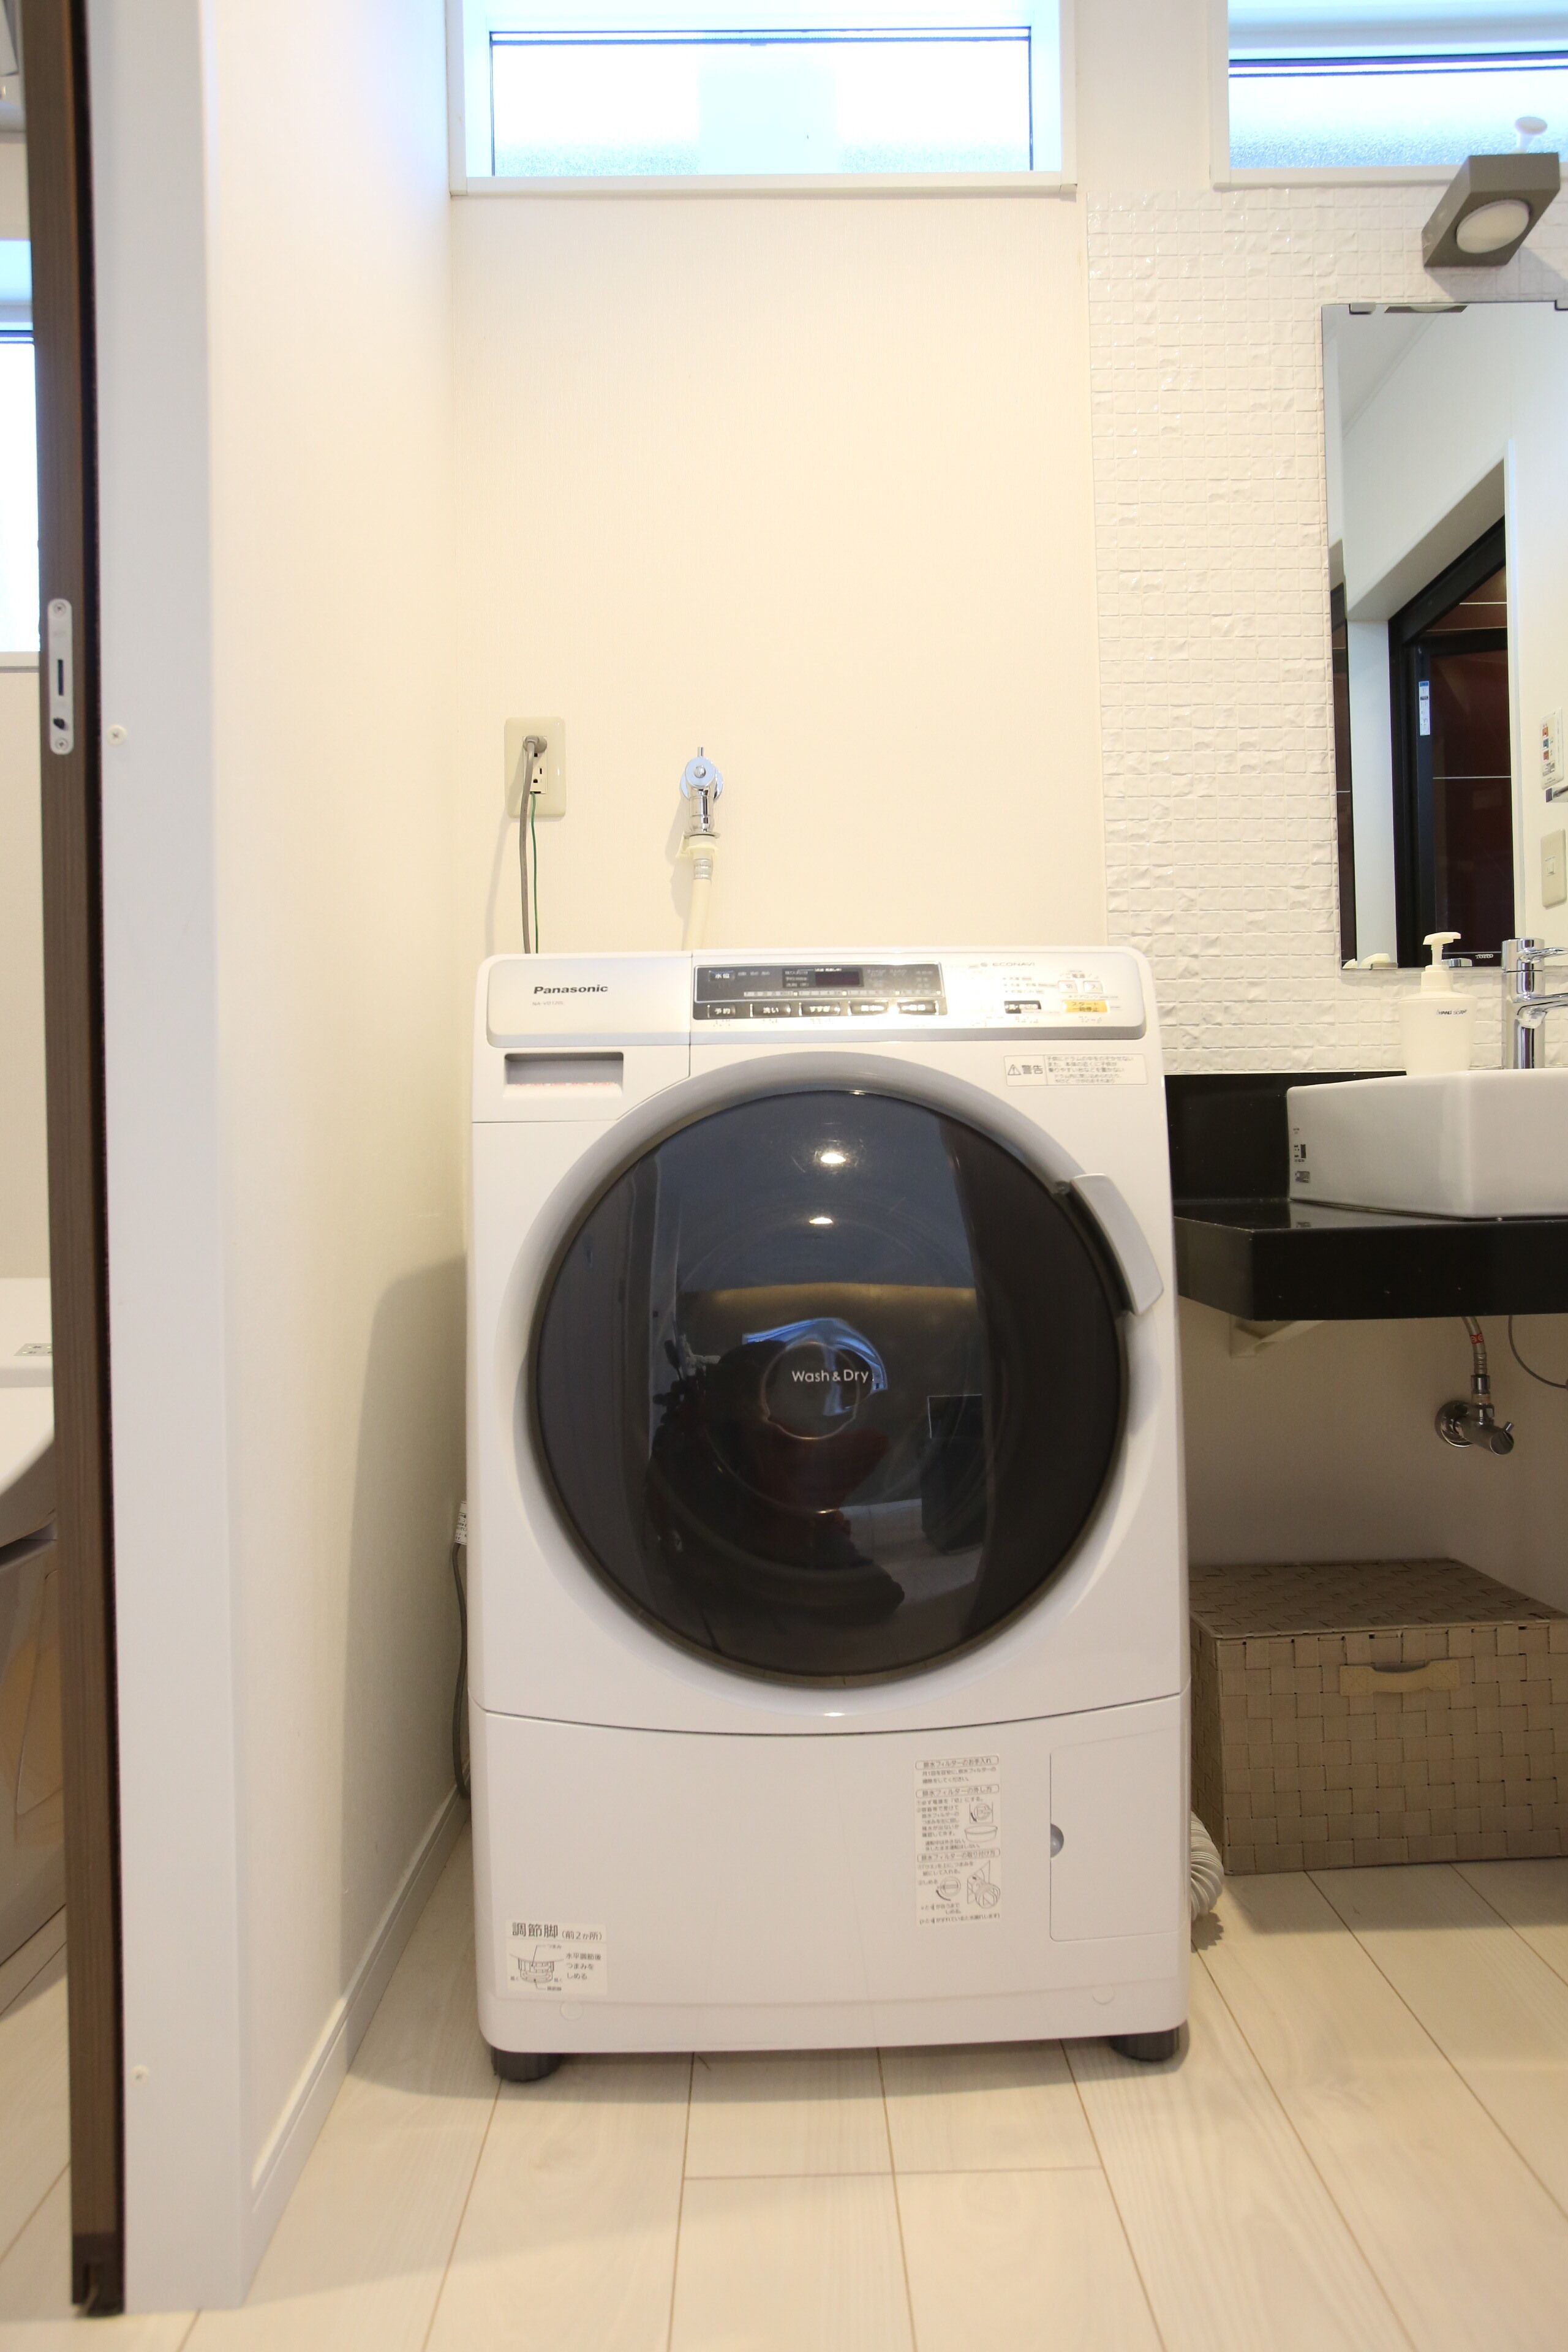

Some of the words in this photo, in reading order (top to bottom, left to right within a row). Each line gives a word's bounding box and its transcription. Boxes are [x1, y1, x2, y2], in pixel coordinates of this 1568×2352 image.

[533, 984, 608, 994] Panasonic
[1022, 1065, 1044, 1074] 警告
[791, 1370, 829, 1382] Wash
[843, 1369, 869, 1384] Dry
[511, 1922, 559, 1939] 調節脚
